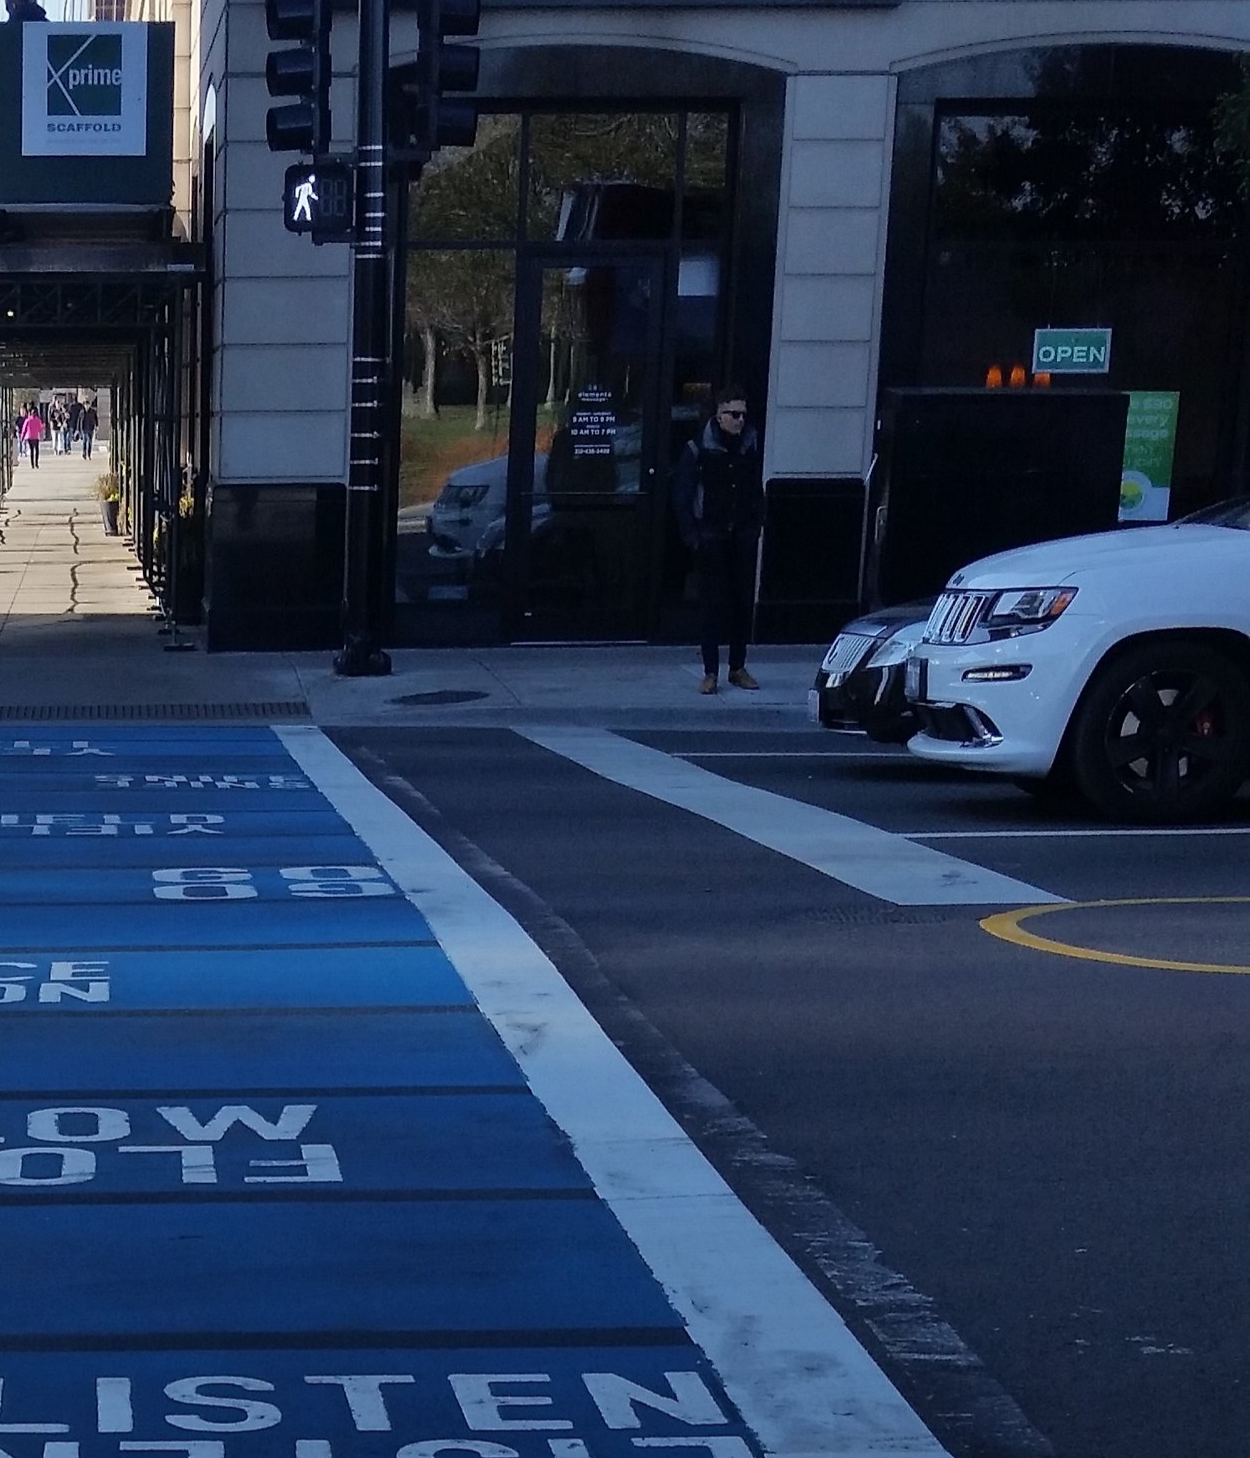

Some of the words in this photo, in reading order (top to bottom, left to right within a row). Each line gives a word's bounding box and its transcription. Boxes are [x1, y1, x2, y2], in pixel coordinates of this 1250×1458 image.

[47, 123, 122, 132] SCAFFOLD
[1038, 346, 1105, 363] OPEN
[152, 866, 384, 883] GO
[152, 881, 396, 900] GO
